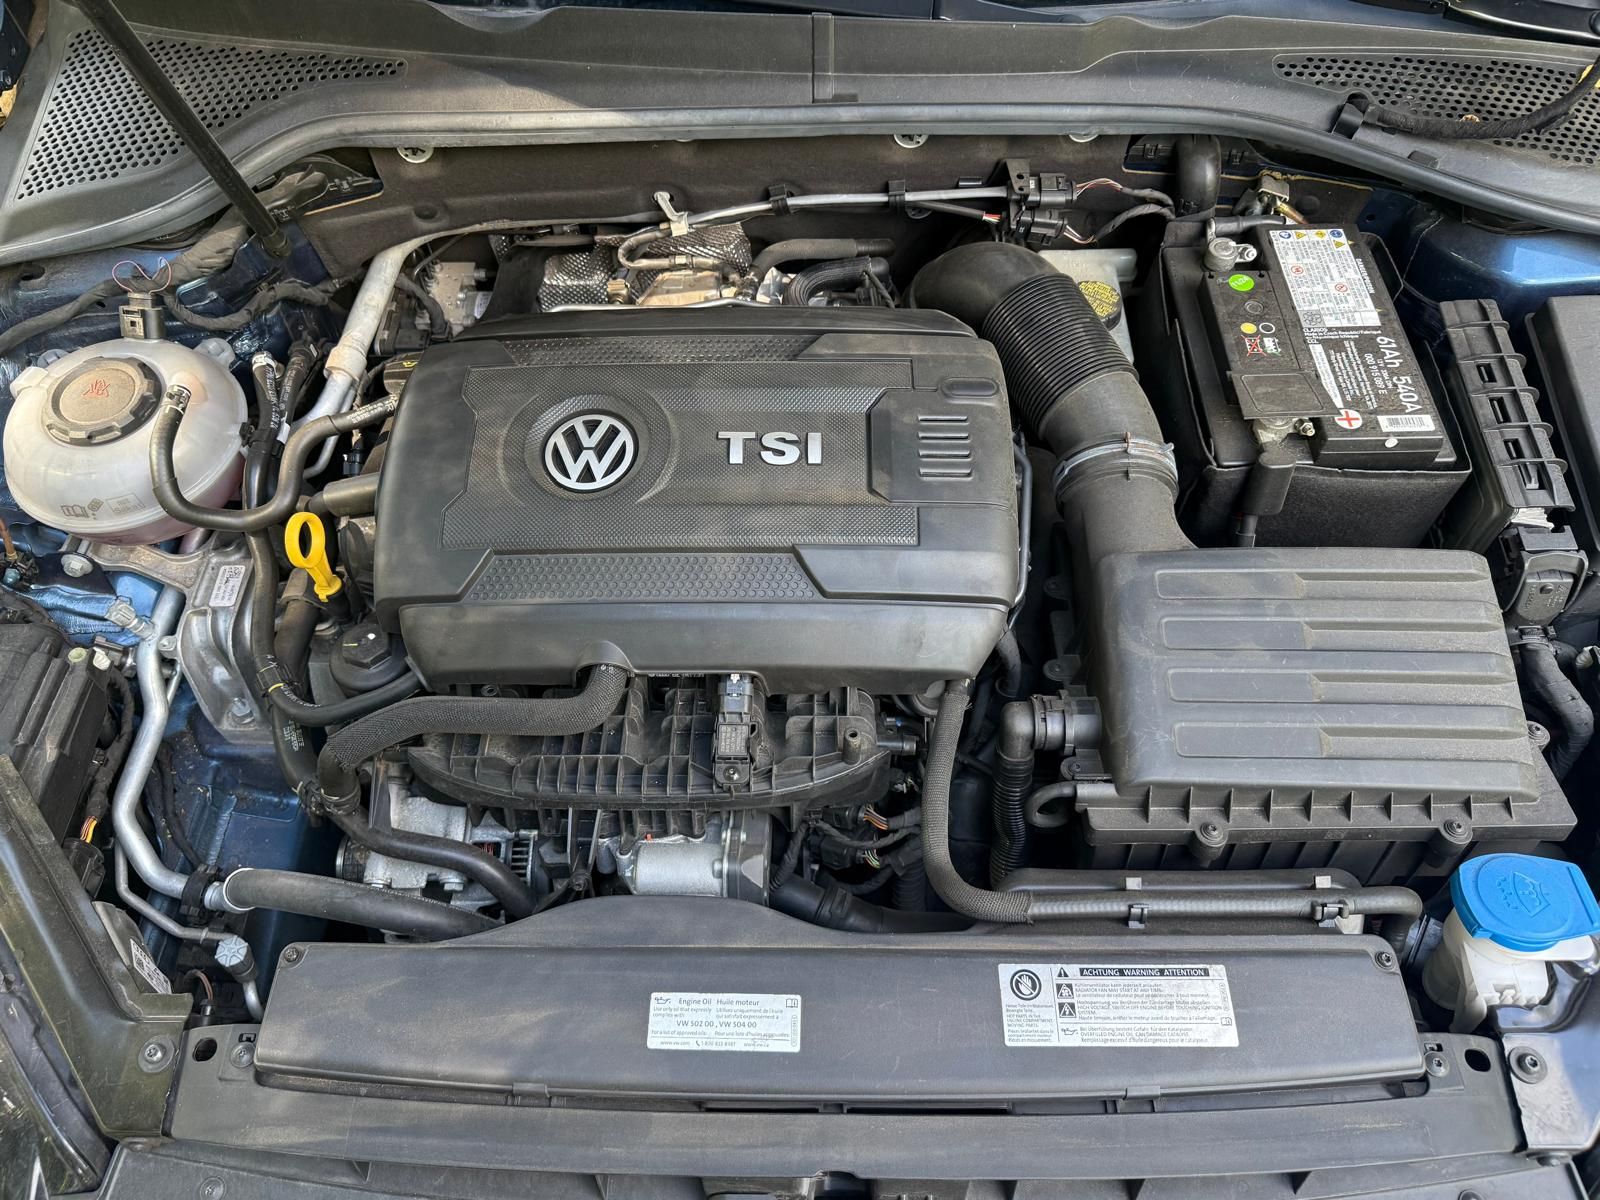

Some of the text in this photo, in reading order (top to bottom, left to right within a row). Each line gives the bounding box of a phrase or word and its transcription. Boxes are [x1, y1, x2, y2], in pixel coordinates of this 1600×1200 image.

[1364, 354, 1375, 364] 000
[1369, 366, 1380, 376] 915
[1376, 337, 1404, 368] 61Ah
[1393, 376, 1422, 412] 540A
[718, 431, 821, 465] TSI
[1082, 968, 1205, 976] ACHTUNG WARNING ATTENTION
[678, 998, 700, 1006] Engine
